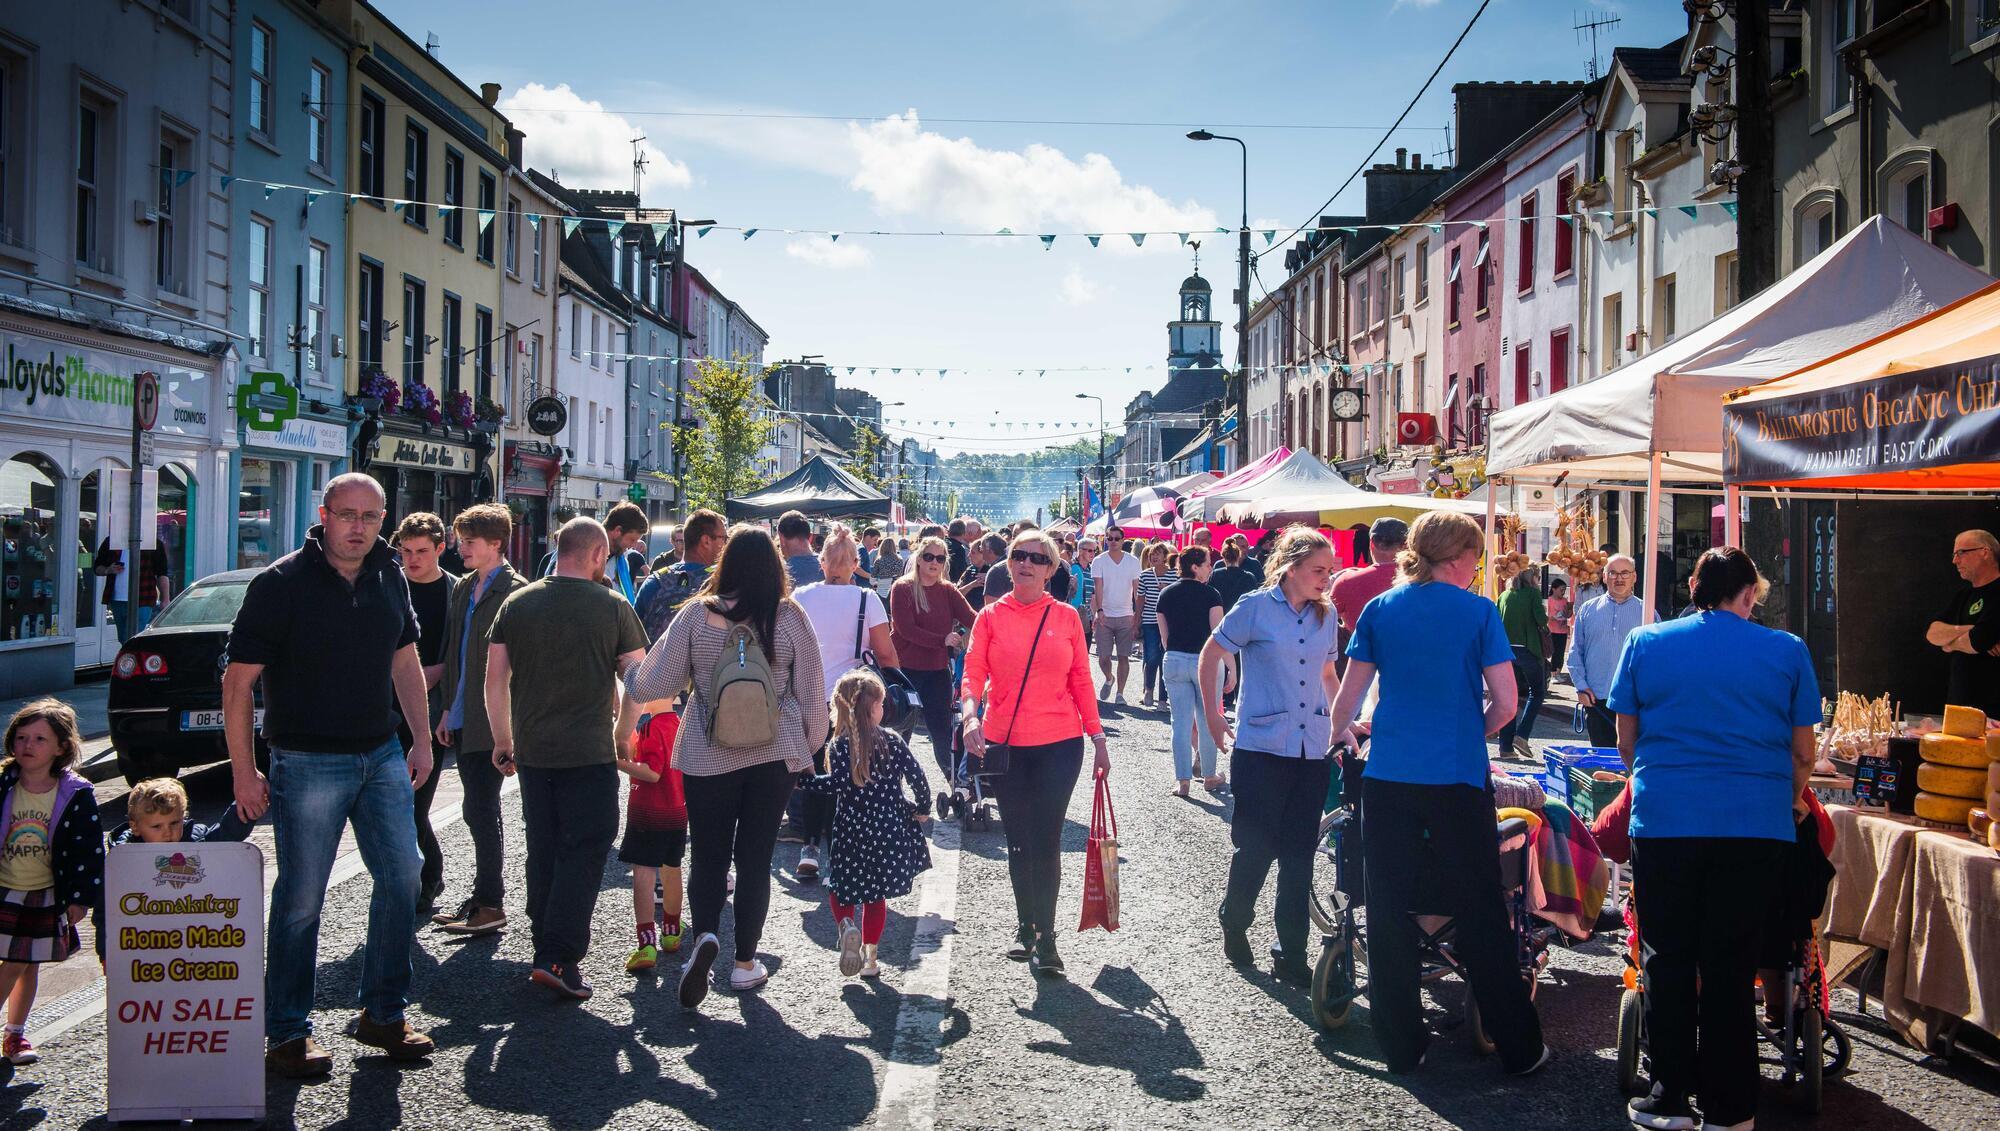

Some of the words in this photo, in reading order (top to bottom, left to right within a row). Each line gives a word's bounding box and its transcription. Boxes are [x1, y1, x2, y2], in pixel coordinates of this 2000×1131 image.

[1863, 390, 1950, 429] ORGANIC
[1956, 375, 2000, 416] CHE
[174, 408, 206, 425] O'CONNORS
[1803, 447, 1863, 471] HANDMADE
[1865, 445, 1877, 466] IN
[1883, 441, 1915, 464] EAST
[1919, 435, 1952, 461] CORK
[119, 892, 240, 919] Clonakilty
[120, 926, 182, 950] Home
[186, 924, 246, 949] Made
[131, 959, 165, 982] Ice
[168, 957, 239, 982] Cream
[117, 1000, 163, 1023] ON
[172, 997, 255, 1022] SALE
[143, 1030, 229, 1055] HERE
